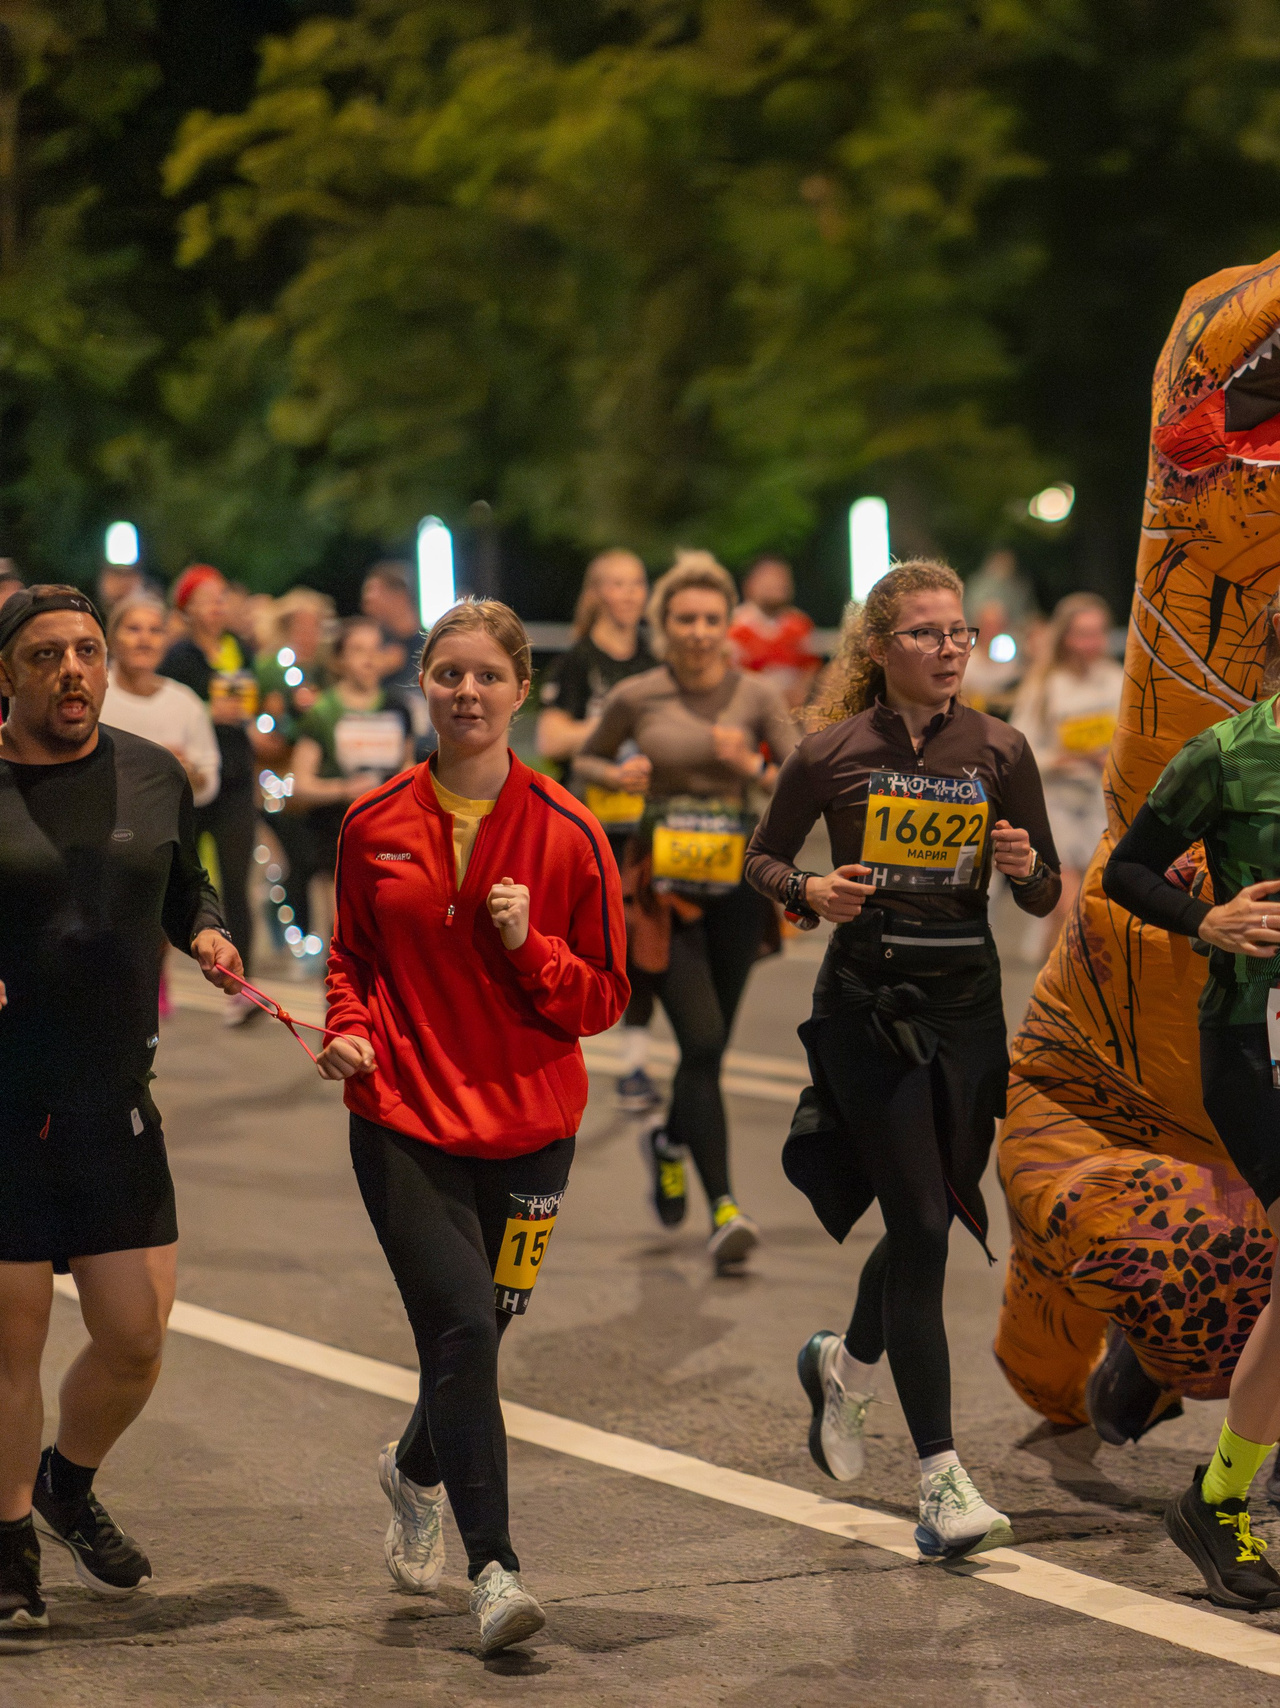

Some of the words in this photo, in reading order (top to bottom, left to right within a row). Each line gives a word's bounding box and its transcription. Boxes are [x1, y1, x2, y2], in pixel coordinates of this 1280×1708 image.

[875, 806, 984, 848] 16622
[907, 848, 948, 861] МАРИЯ
[511, 1226, 553, 1267] 15
